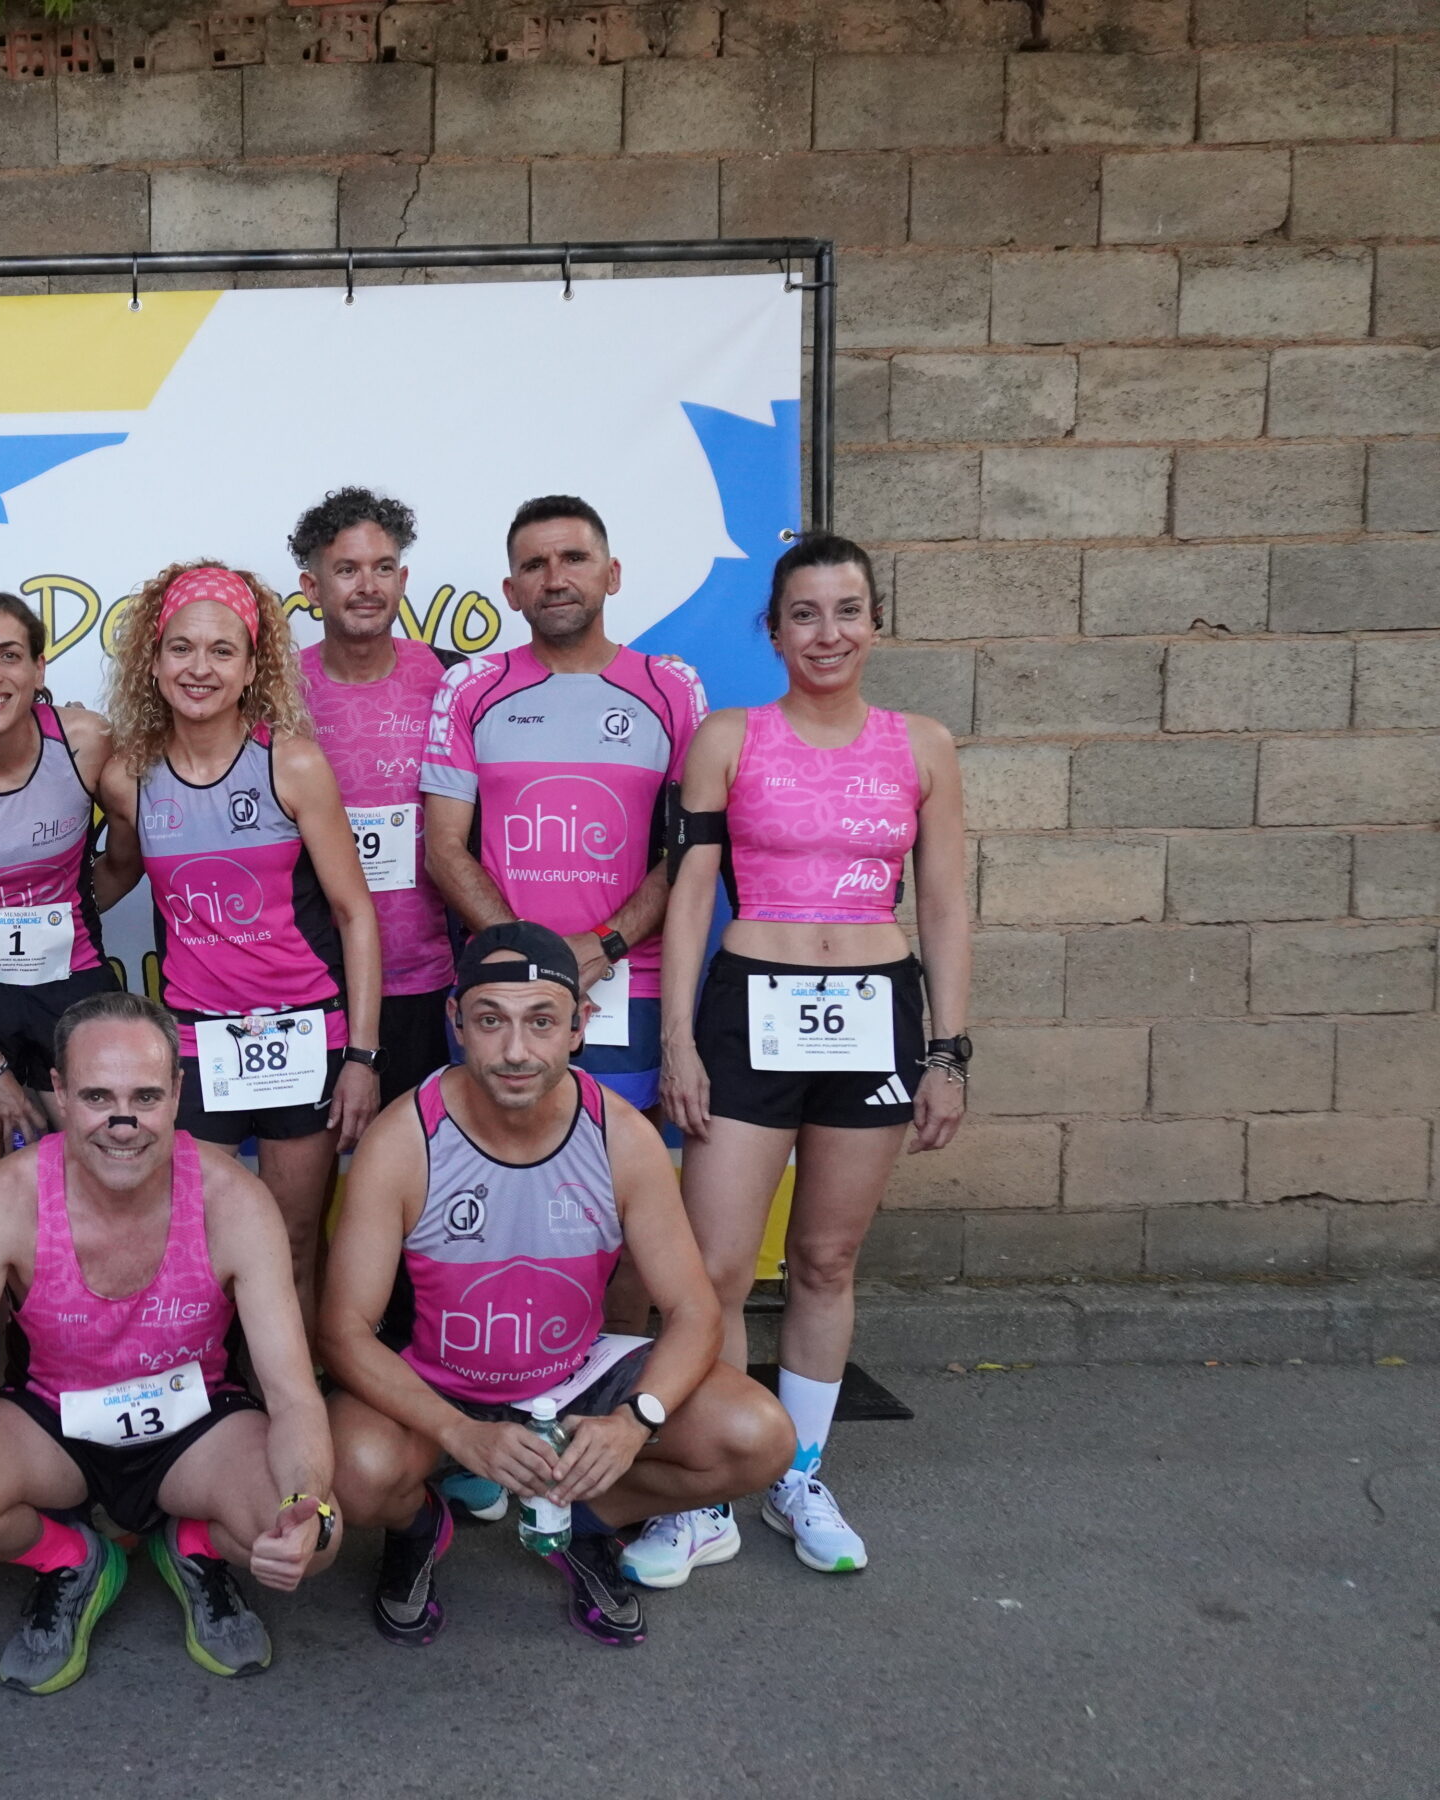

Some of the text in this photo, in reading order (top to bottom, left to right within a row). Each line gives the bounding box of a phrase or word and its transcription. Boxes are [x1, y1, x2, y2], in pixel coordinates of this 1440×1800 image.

[517, 715, 545, 724] TACTIC
[764, 777, 797, 787] TACTIC
[8, 930, 26, 956] 1
[799, 1004, 845, 1034] 56
[244, 1041, 287, 1073] 88
[103, 1393, 131, 1406] CARLOS
[116, 1407, 165, 1440] 13
